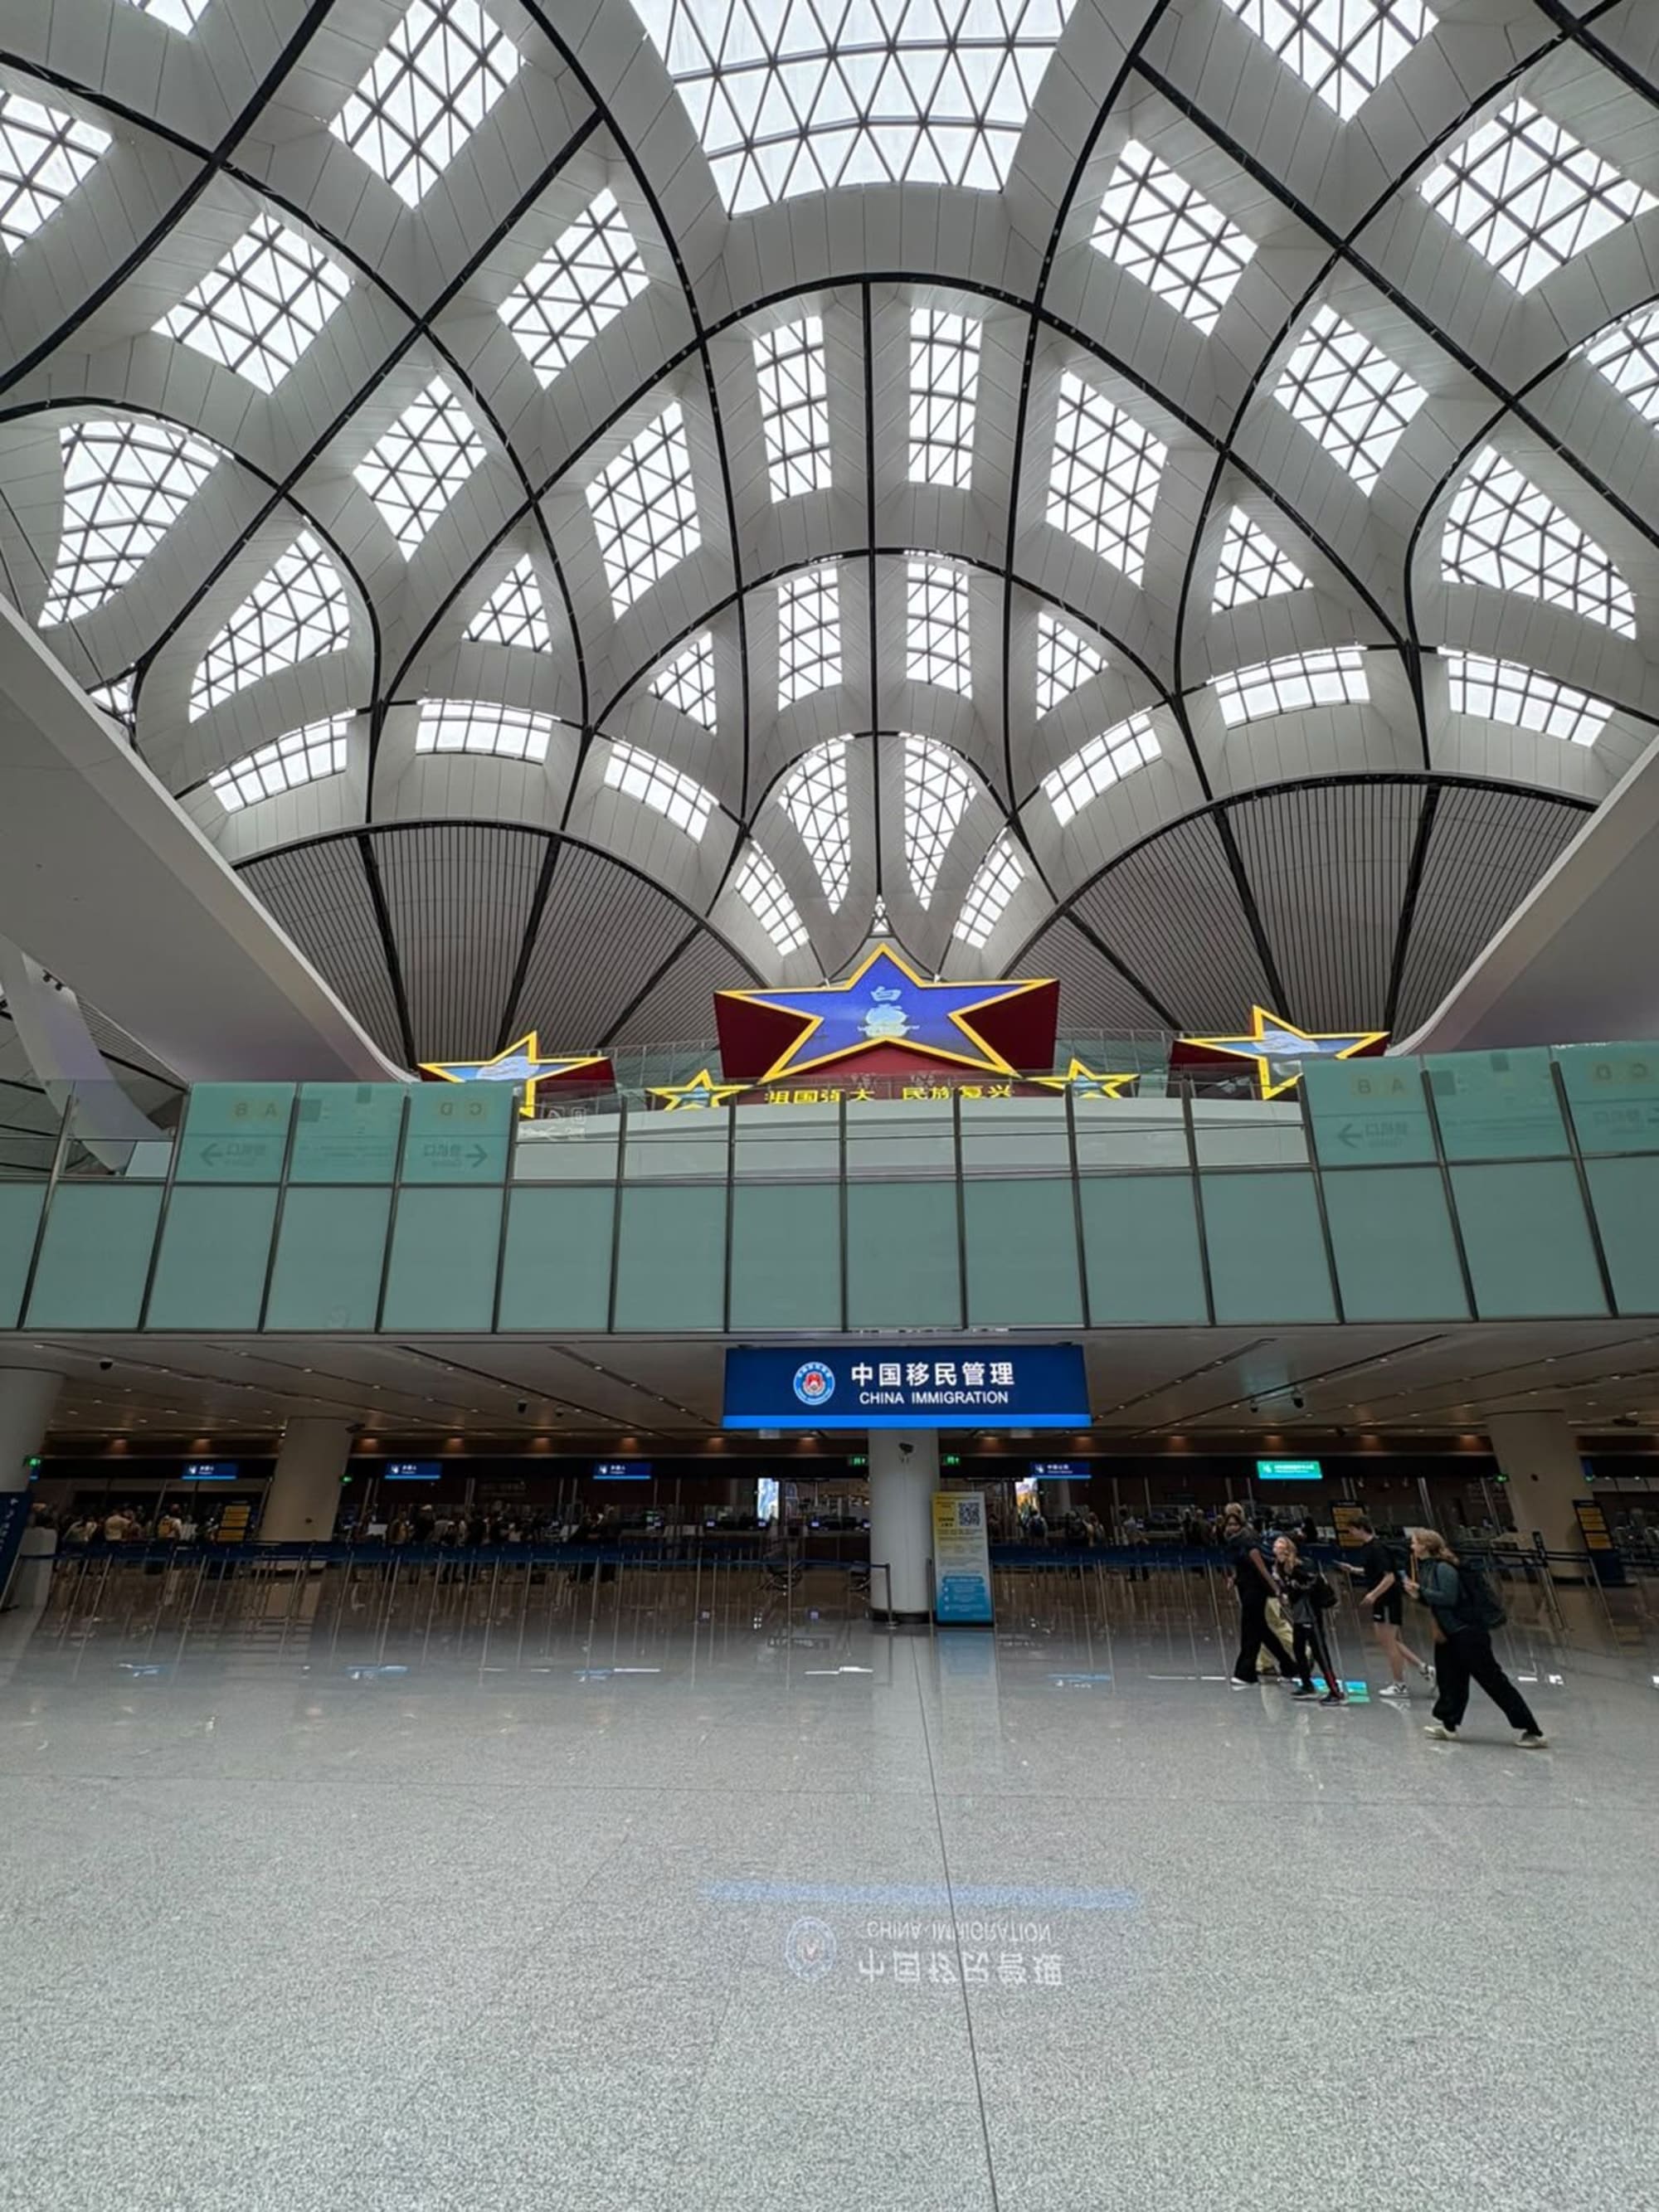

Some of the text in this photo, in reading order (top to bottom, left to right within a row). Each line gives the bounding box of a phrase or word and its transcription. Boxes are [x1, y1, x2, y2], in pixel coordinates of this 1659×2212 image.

[851, 1362, 1014, 1387] 中国移民管理
[859, 1391, 1008, 1404] CHINA IMMIGRATION
